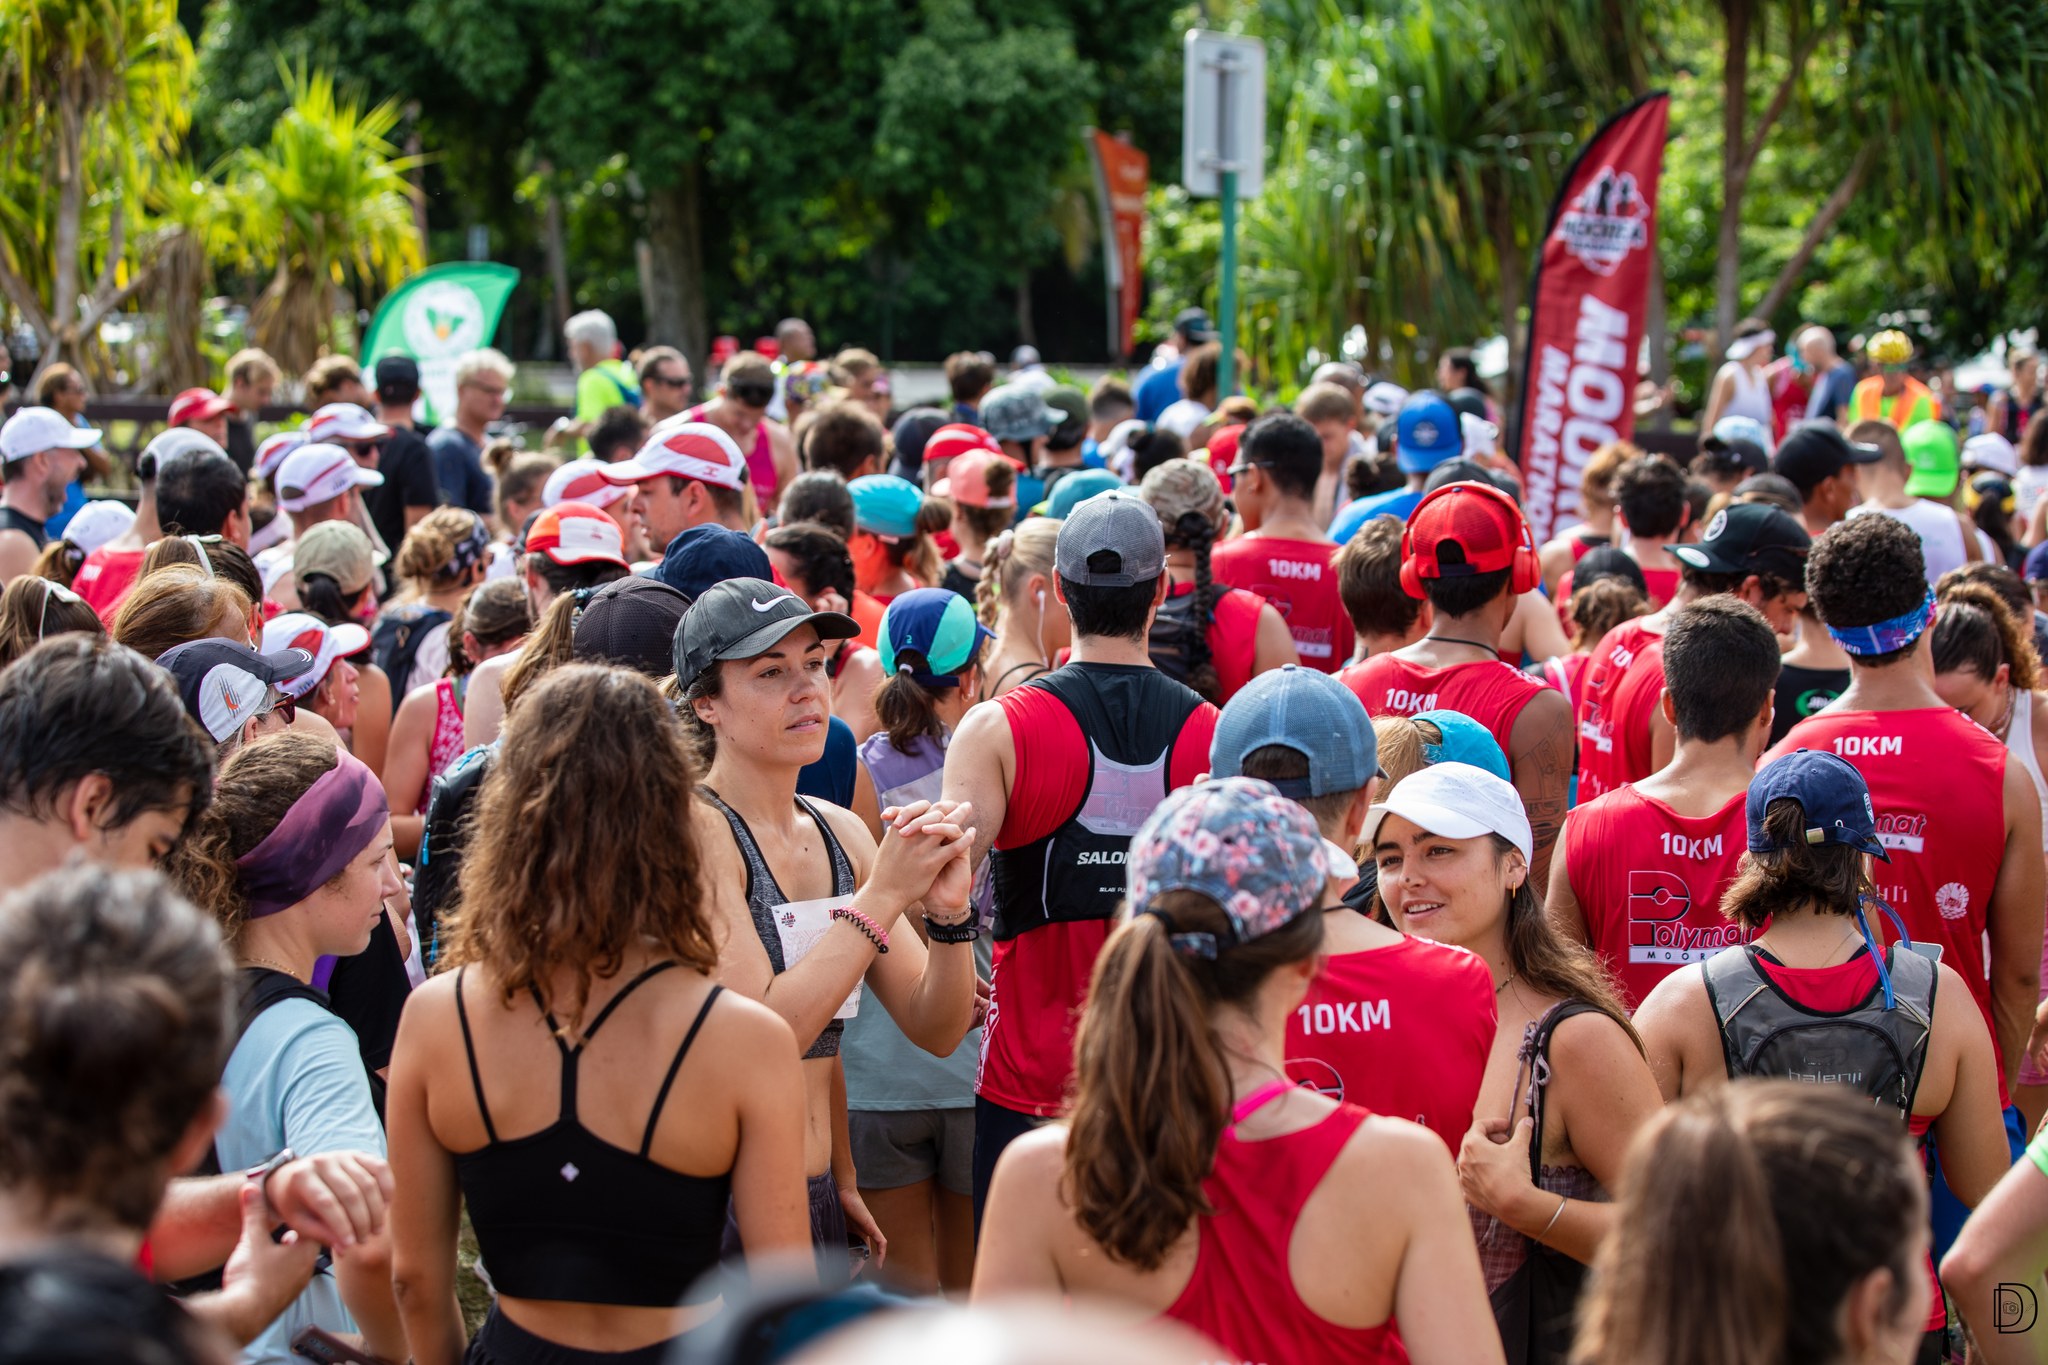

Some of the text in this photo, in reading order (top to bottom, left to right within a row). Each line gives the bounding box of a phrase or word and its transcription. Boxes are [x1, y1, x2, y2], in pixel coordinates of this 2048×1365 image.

[1268, 559, 1321, 581] 10KM
[1386, 688, 1438, 713] 10KM
[1833, 736, 1902, 756] 10KM
[1660, 832, 1723, 860] 10KM
[1647, 951, 1720, 961] MOOR
[1298, 999, 1391, 1035] 10KM
